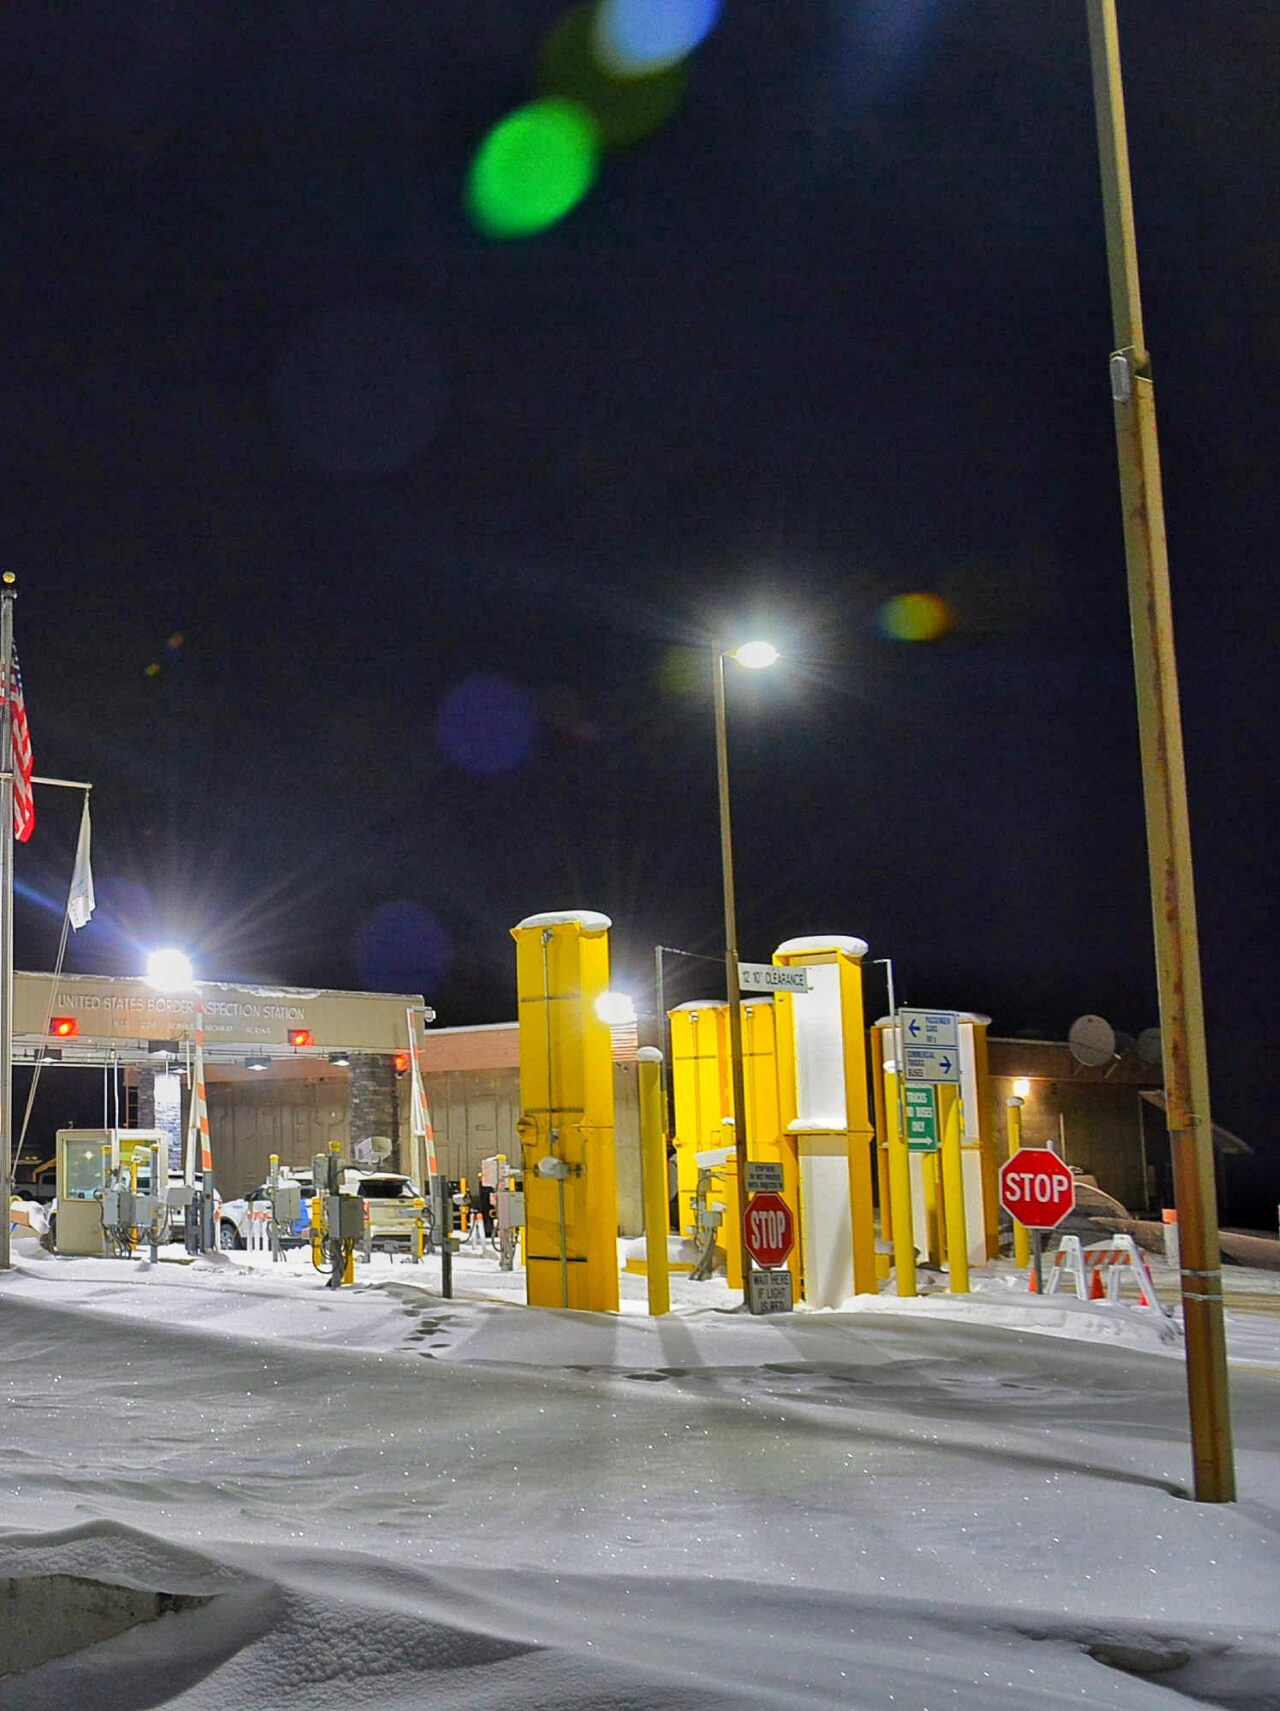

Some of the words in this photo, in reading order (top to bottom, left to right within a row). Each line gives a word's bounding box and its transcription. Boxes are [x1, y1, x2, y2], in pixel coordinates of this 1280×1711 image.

[765, 972, 804, 987] CLEARANCE
[58, 994, 100, 1009] UNITED
[103, 996, 143, 1012] STATES
[147, 998, 194, 1014] BORDER
[263, 1005, 305, 1020] STATION
[1005, 1172, 1069, 1203] STOP
[751, 1210, 786, 1250] STOP
[770, 1273, 790, 1285] HERE
[766, 1287, 786, 1299] LIGHT
